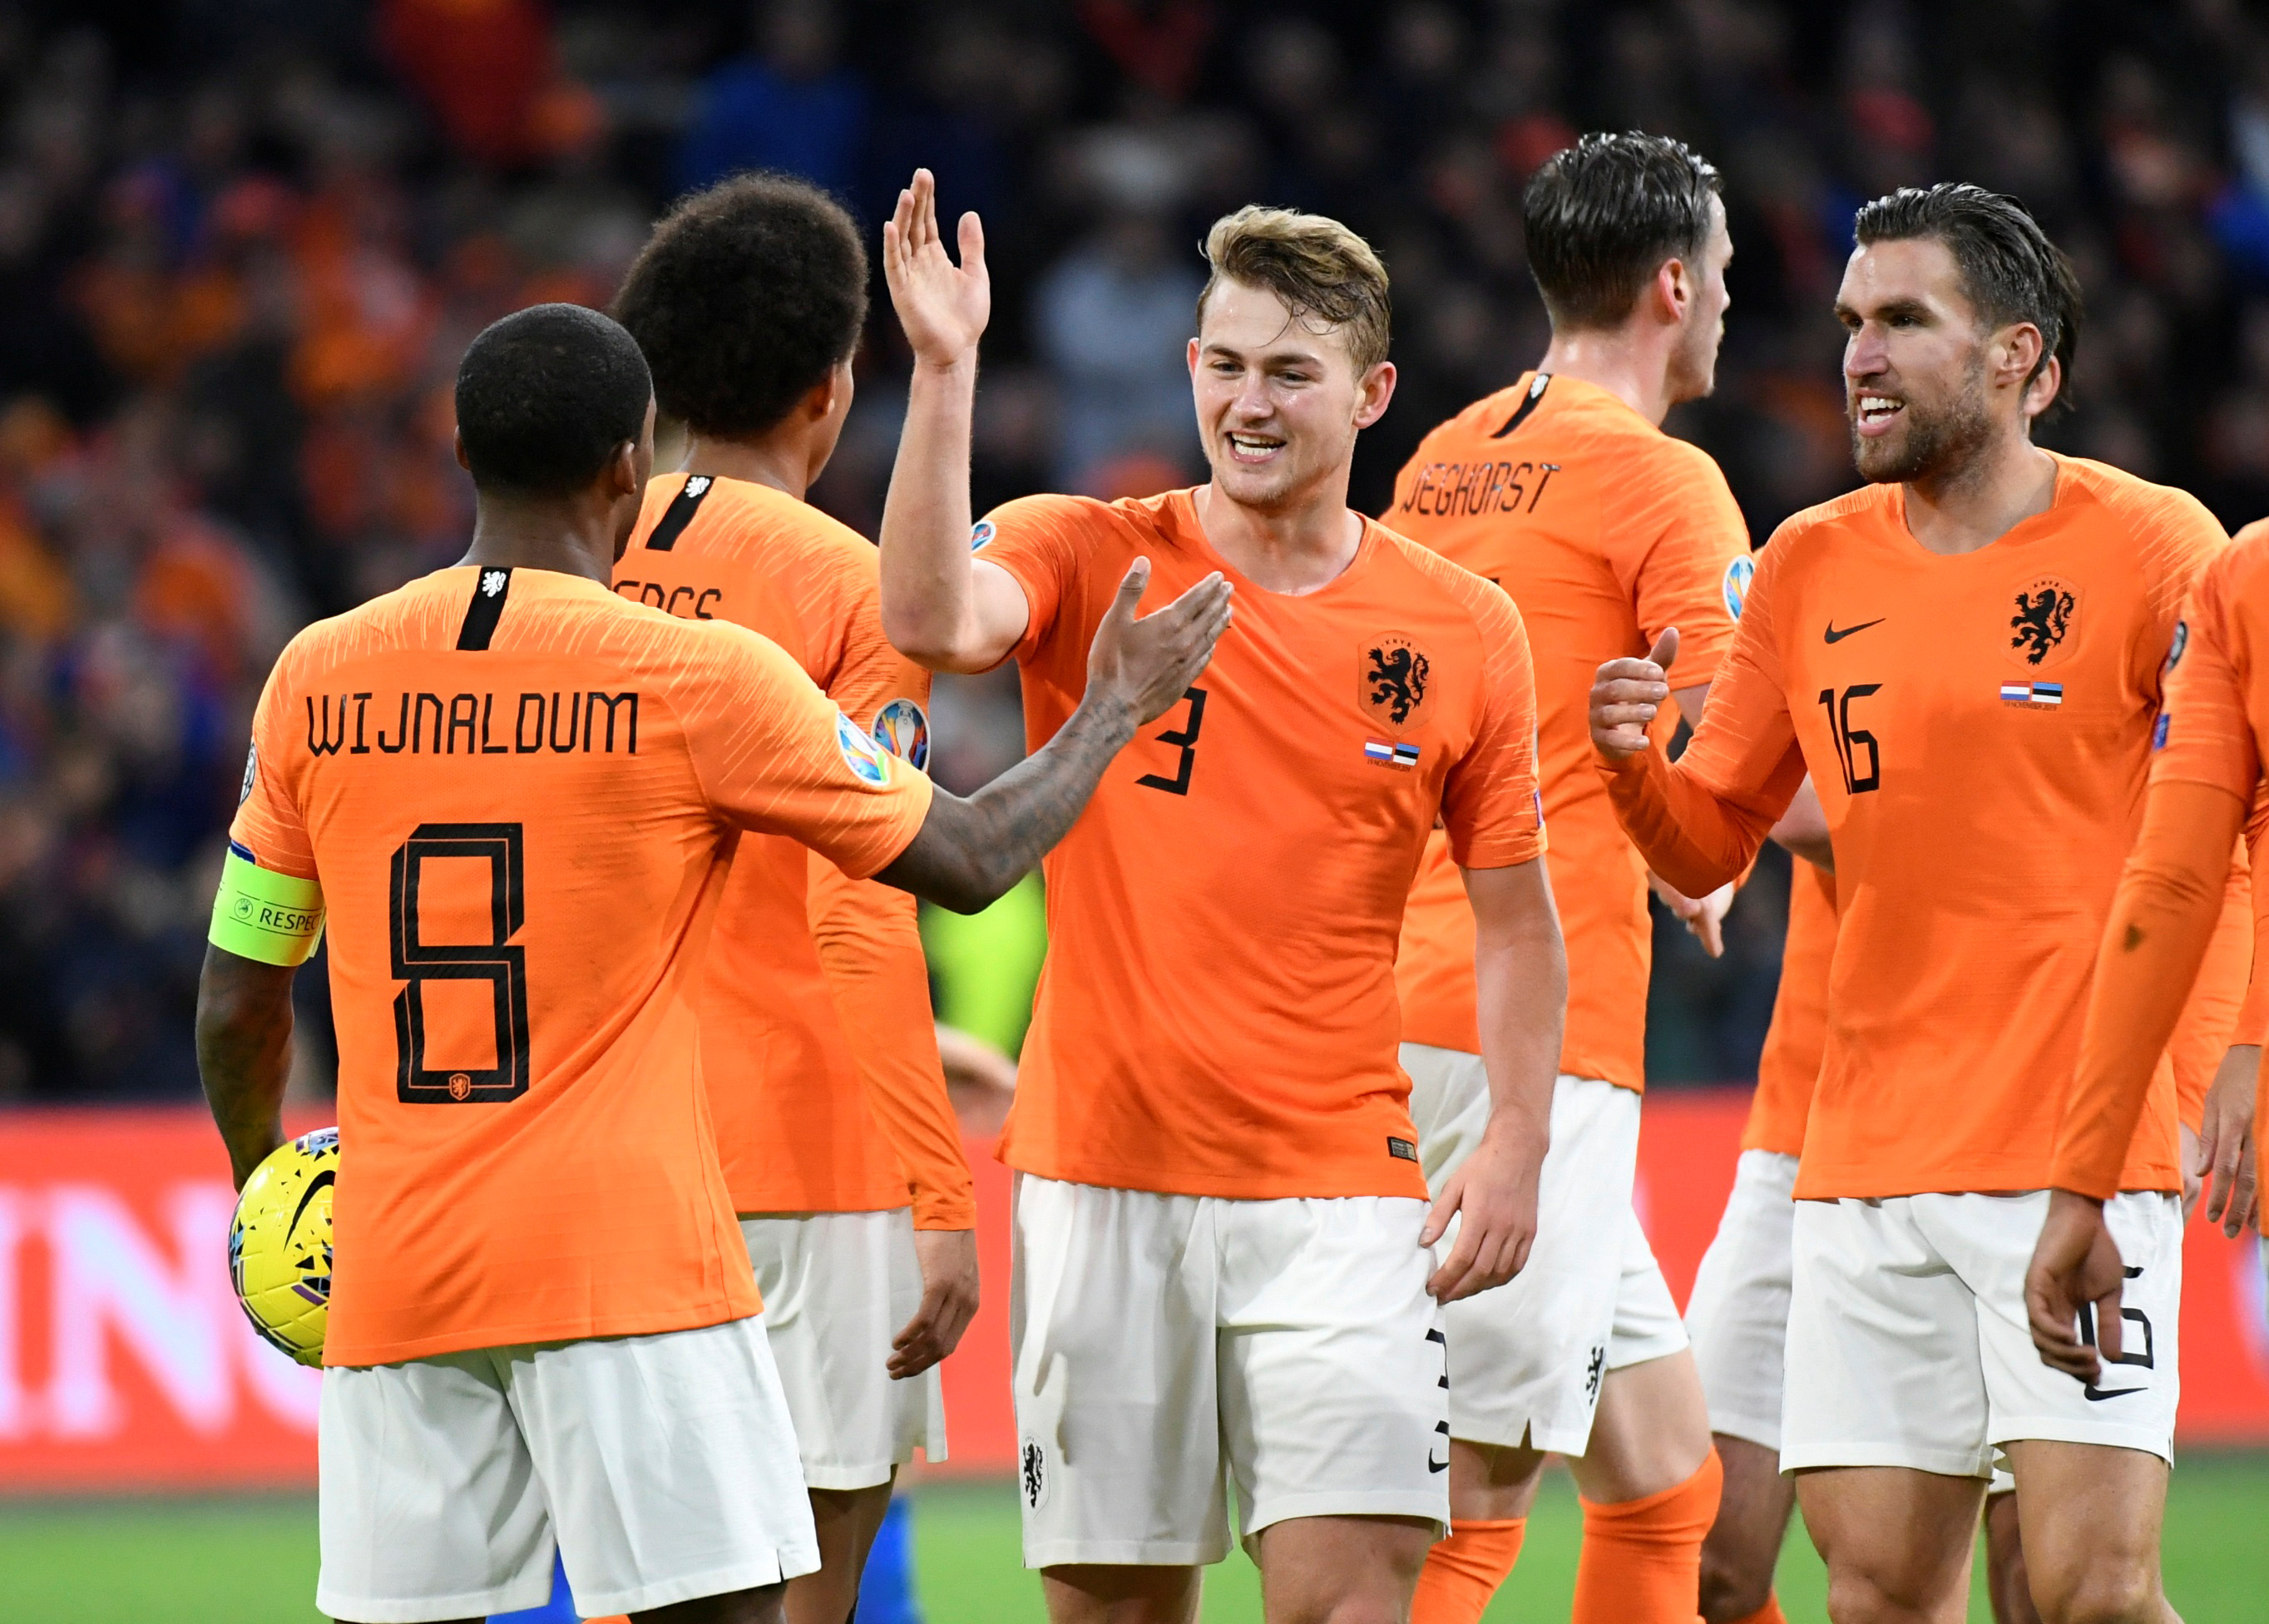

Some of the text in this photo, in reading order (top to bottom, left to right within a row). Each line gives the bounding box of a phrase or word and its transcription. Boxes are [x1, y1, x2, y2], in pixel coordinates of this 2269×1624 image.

[306, 692, 640, 758] WIJNALDUM
[1134, 686, 1208, 796] 3
[1818, 683, 1884, 796] 16
[389, 822, 530, 1104] 8
